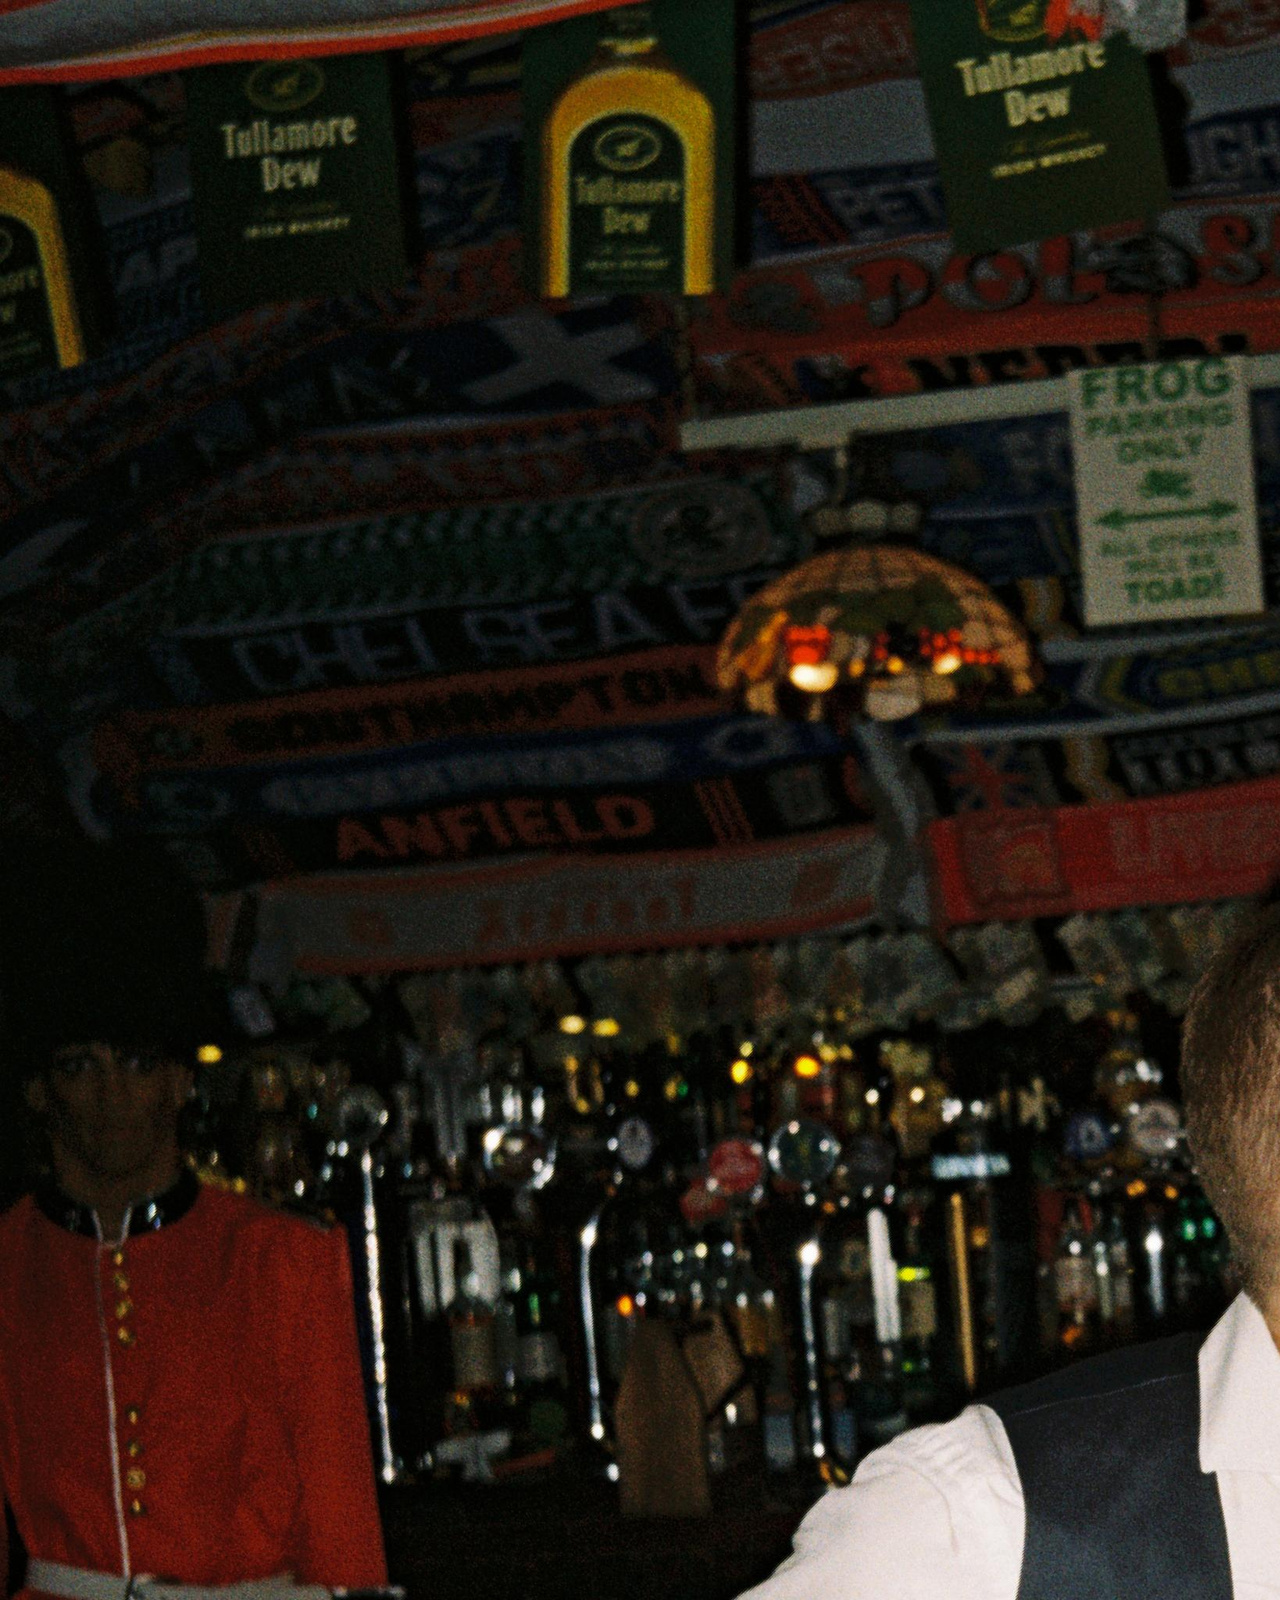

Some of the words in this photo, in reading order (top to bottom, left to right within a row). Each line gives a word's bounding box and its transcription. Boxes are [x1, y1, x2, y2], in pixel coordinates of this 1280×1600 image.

[954, 43, 1107, 97] Tullamore
[1003, 85, 1072, 128] Dew
[220, 114, 359, 160] Tullamore
[261, 155, 322, 193] Dew
[1081, 355, 1233, 409] FROG
[1084, 403, 1234, 438] PARKING
[336, 793, 656, 864] ANFIELD
